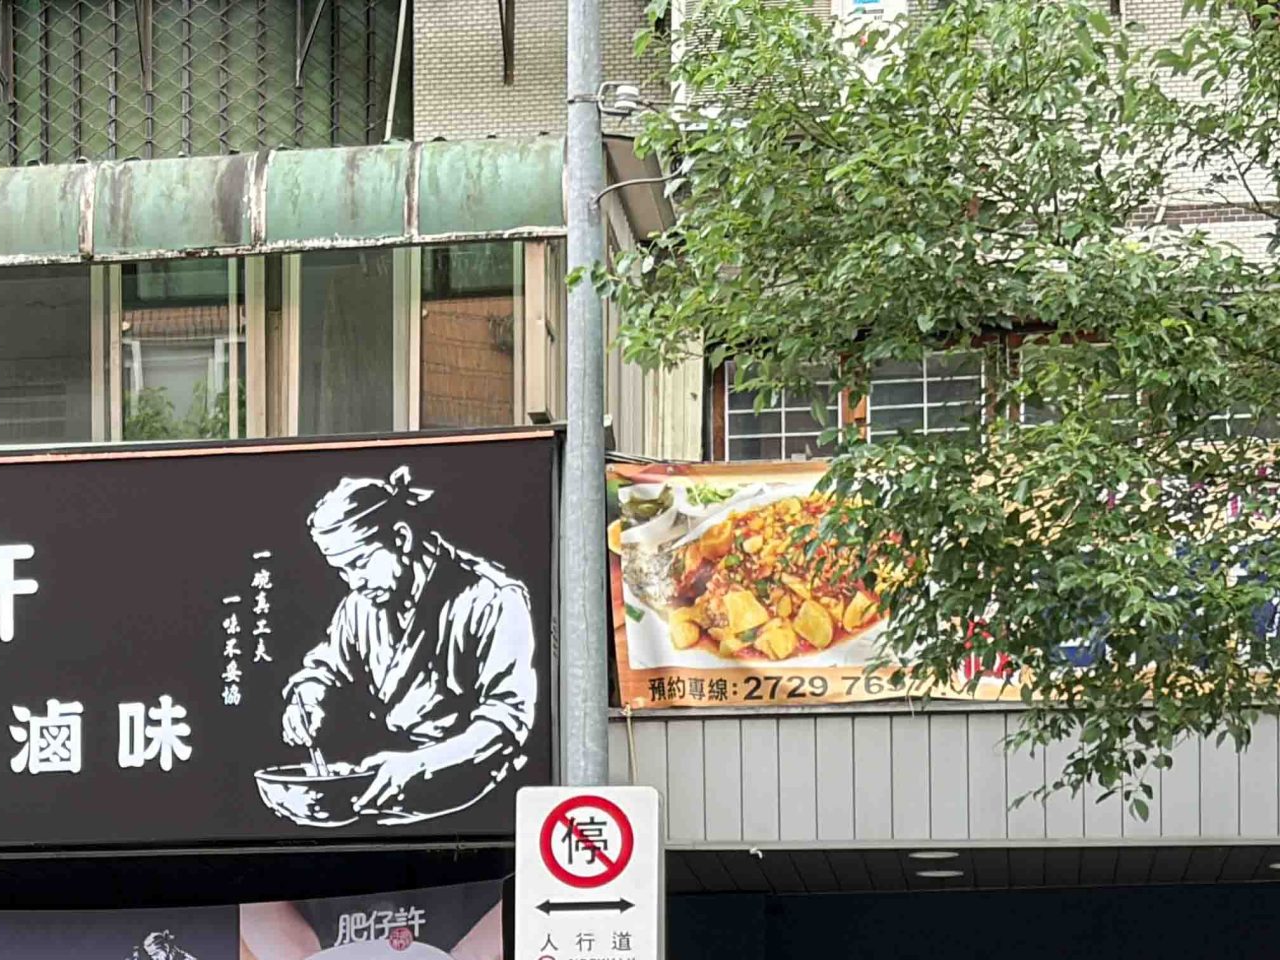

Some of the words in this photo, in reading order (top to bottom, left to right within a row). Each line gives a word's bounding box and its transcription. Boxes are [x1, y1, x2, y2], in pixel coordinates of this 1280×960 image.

[251, 550, 273, 662] 一碗真工夫
[222, 595, 242, 706] 一味不妥協
[561, 816, 609, 866] 停
[334, 906, 427, 947] 肥仔許
[540, 931, 632, 952] 人行道
